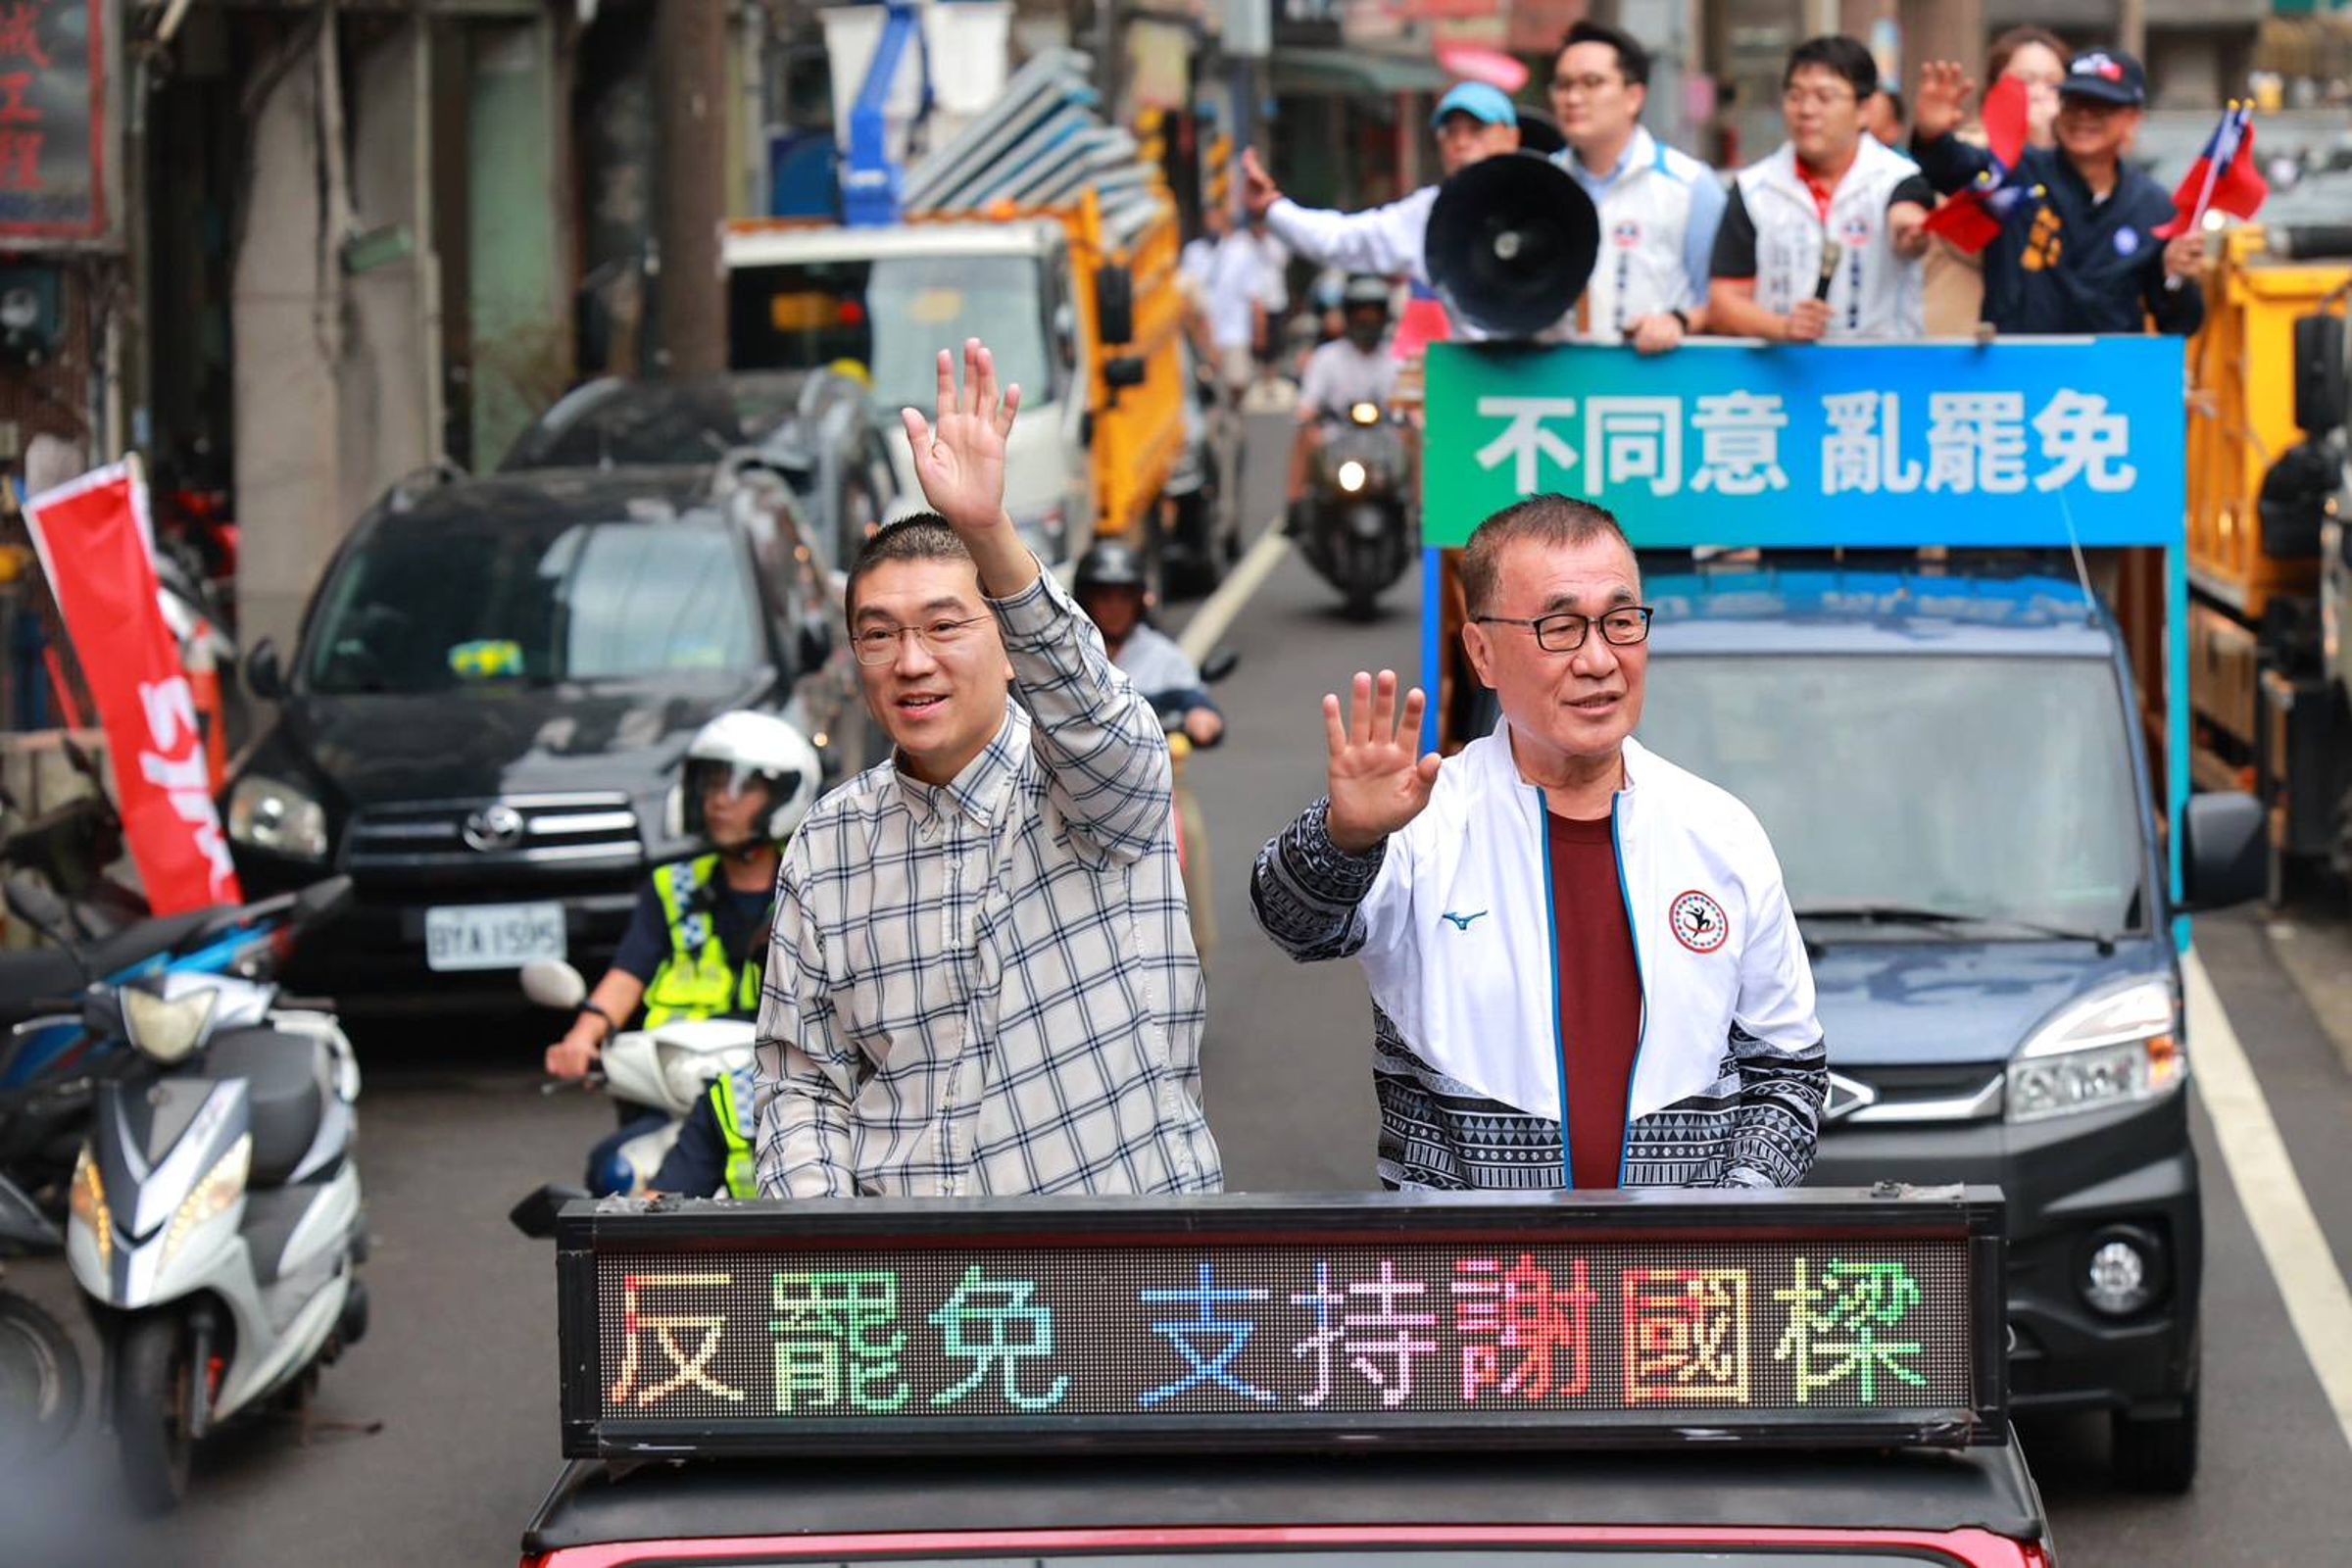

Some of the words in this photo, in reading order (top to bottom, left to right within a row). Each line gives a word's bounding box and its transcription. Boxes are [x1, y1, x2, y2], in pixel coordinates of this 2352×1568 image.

[1475, 389, 1790, 497] 不同意
[1820, 387, 2138, 496] 亂罷免
[612, 1265, 1073, 1411] 反罷免
[1138, 1254, 1928, 1407] 支持謝國樑
